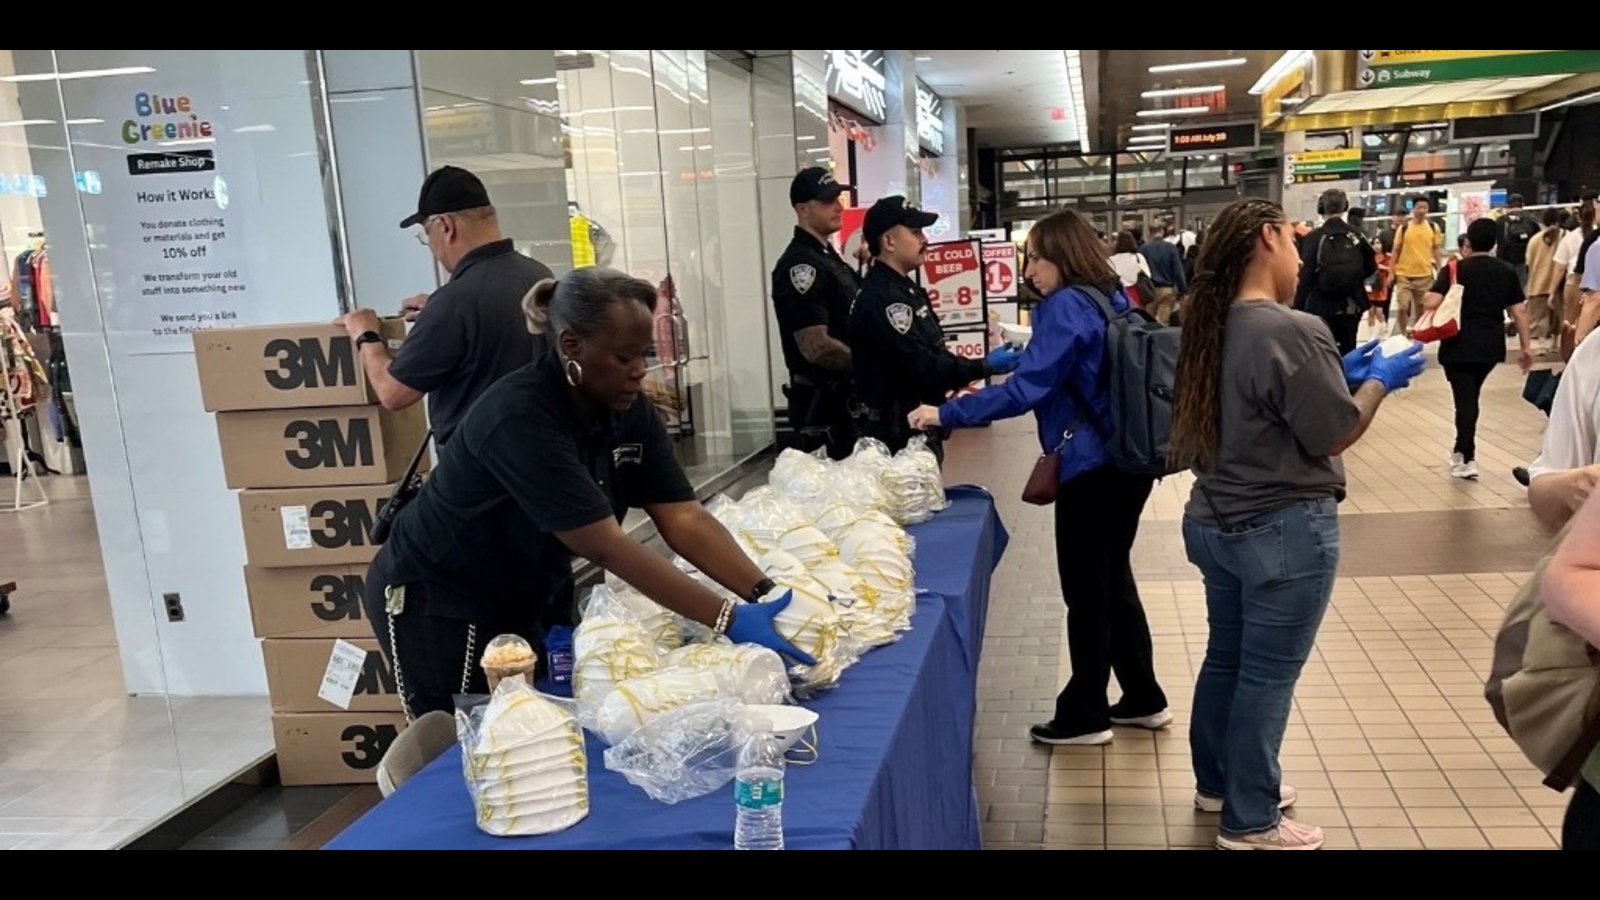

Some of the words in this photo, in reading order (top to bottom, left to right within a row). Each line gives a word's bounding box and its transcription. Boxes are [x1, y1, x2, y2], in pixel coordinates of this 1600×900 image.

[1393, 69, 1430, 79] Subway
[135, 92, 191, 116] Blue
[121, 114, 212, 144] Greenie
[137, 158, 177, 169] Remake
[179, 157, 205, 168] Shop
[137, 191, 164, 203] How
[167, 190, 176, 201] it
[179, 188, 216, 201] Works
[140, 221, 156, 229] You
[158, 220, 187, 228] donate
[189, 218, 225, 227] clothing
[154, 233, 192, 241] materials
[194, 231, 210, 240] and
[212, 231, 225, 241] get
[162, 247, 187, 258] 10%
[190, 245, 206, 257] off
[924, 251, 941, 262] ICE
[944, 249, 972, 260] COLD
[936, 264, 963, 274] BEER
[158, 272, 200, 281] transform
[202, 272, 221, 280] your
[223, 270, 237, 278] old
[142, 286, 161, 295] stuff
[164, 286, 180, 294] into
[182, 284, 227, 294] something
[160, 314, 174, 322] We
[176, 313, 196, 321] send
[197, 313, 212, 322] you
[221, 311, 237, 319] link
[956, 344, 982, 356] DOG
[264, 336, 356, 390] 3M
[284, 418, 374, 470] 3M
[310, 498, 392, 548] 3M
[353, 650, 397, 695] M
